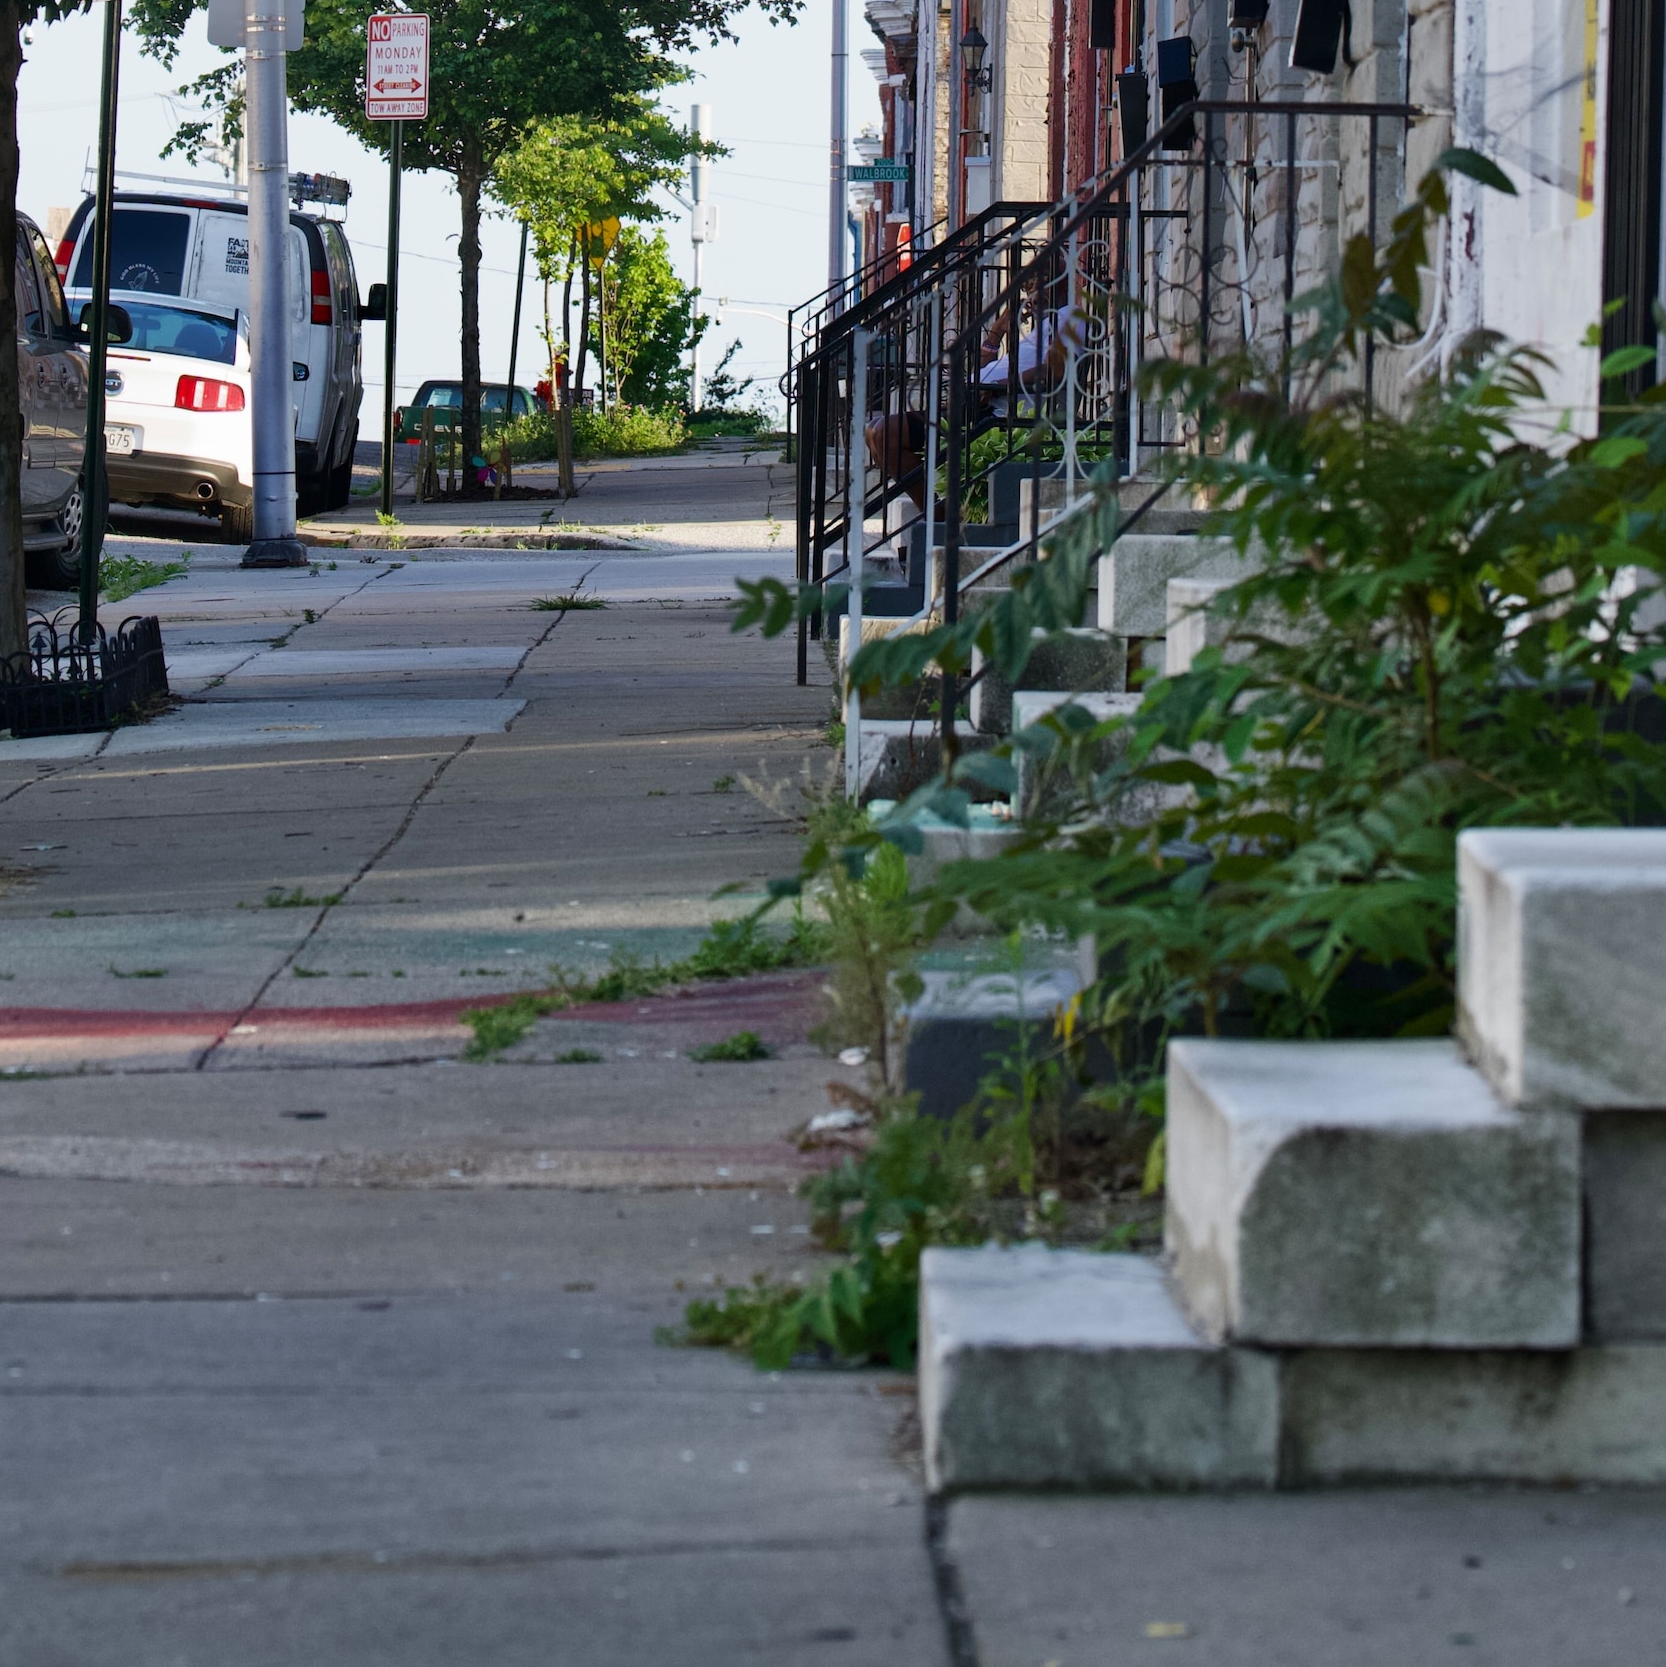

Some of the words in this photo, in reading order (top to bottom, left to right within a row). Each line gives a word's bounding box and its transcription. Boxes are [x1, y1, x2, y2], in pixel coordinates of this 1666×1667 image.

[372, 20, 390, 40] NO
[393, 22, 425, 37] PARKING
[375, 46, 421, 60] MONDAY
[395, 65, 403, 74] TO
[371, 103, 384, 113] TOW
[387, 103, 405, 113] AWAY
[407, 102, 423, 113] ZONE
[855, 168, 905, 179] WALBROOK
